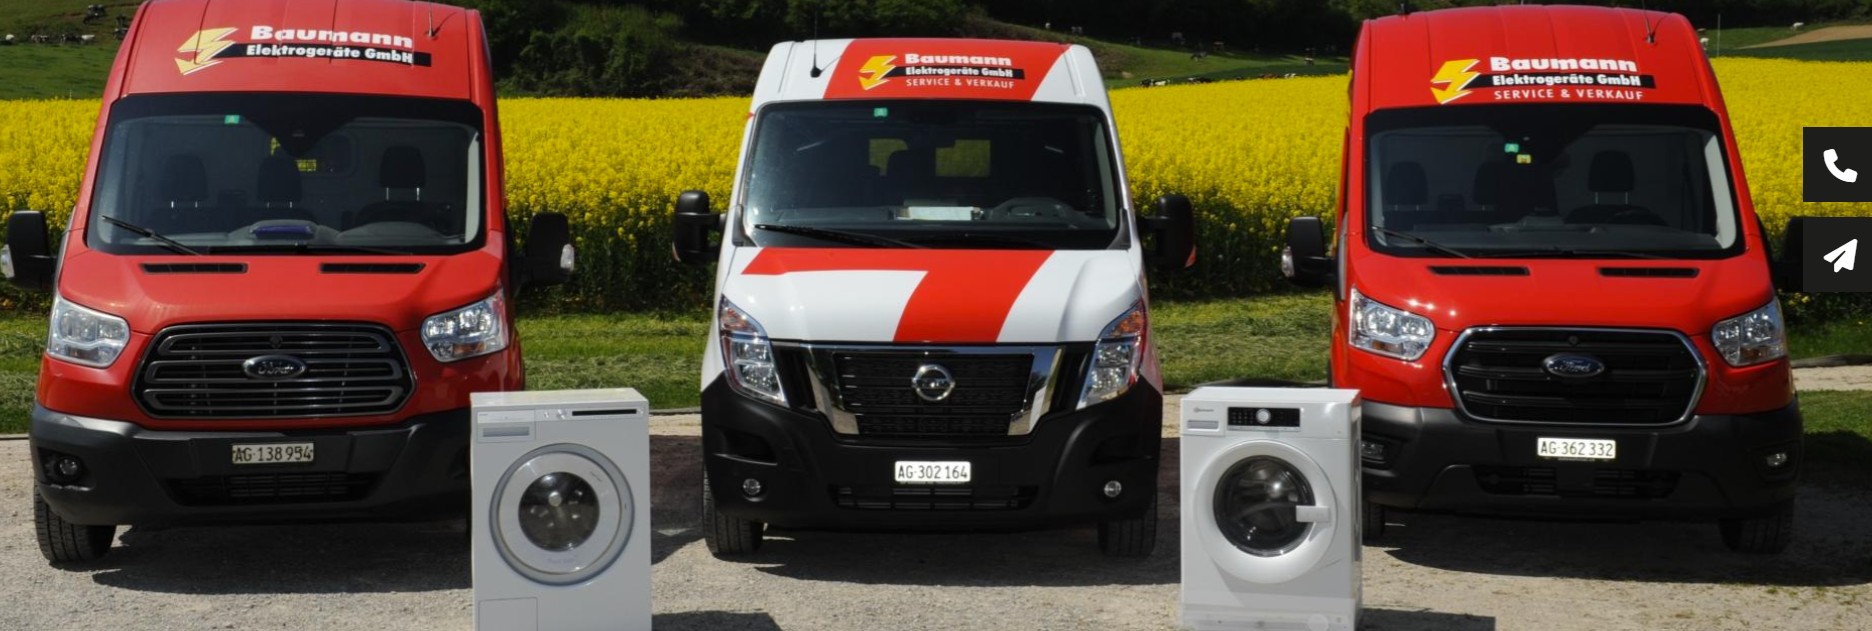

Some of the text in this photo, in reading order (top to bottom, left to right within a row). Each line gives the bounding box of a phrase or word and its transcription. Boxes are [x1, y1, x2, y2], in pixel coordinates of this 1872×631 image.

[250, 25, 413, 48] Baumann
[246, 44, 414, 64] Elektrogeräte GmbH
[905, 53, 1012, 66] Baumann
[1489, 56, 1638, 72] Baumann
[905, 66, 1014, 78] Elektrogeräte GmbH
[906, 78, 1015, 89] SERVICE & VERKAUF
[1492, 74, 1642, 87] Elektrogeräte GmbH
[1494, 88, 1644, 100] SERVICE & VERKAUF
